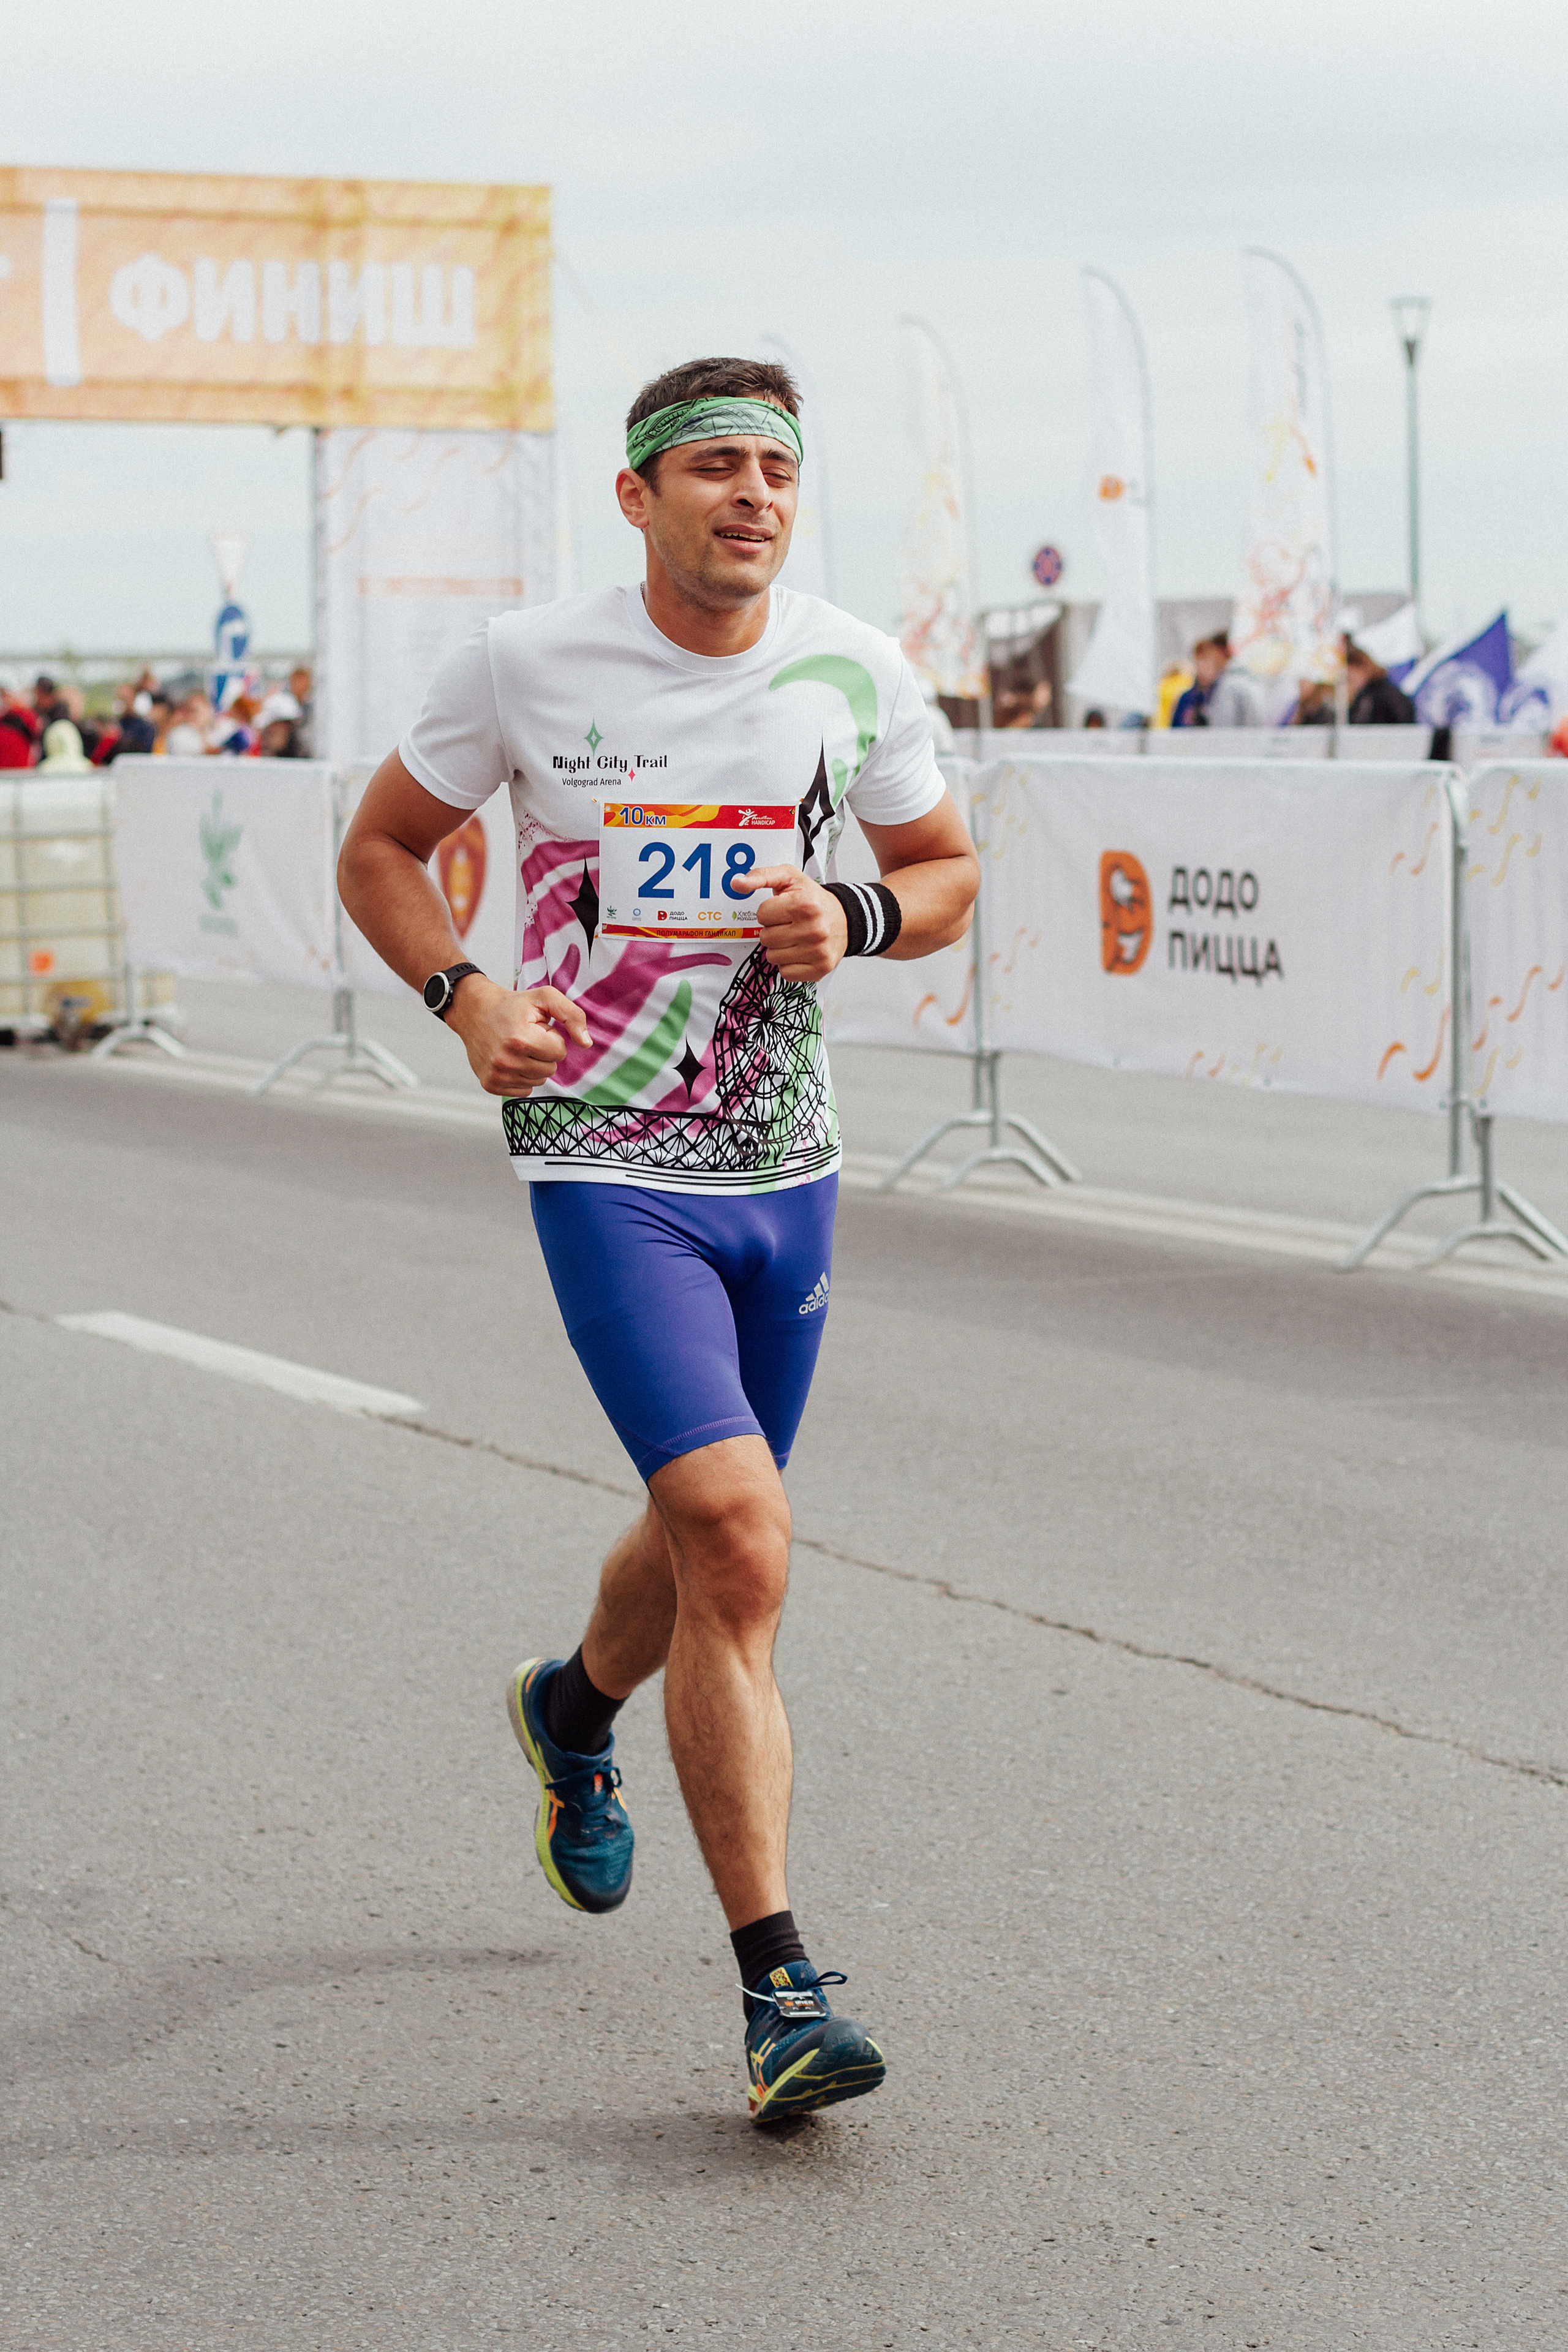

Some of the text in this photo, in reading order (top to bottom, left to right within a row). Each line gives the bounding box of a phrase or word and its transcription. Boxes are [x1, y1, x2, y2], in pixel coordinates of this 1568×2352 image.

[109, 252, 476, 348] ФИНИШ
[552, 755, 668, 774] Night City Trail
[562, 778, 598, 788] Volgograd
[619, 806, 644, 825] 10
[638, 842, 756, 900] 218
[1168, 865, 1259, 919] ДОДО
[698, 911, 722, 921] СТС
[1168, 930, 1285, 987] ПИЦЦА
[798, 1292, 829, 1315] adida
